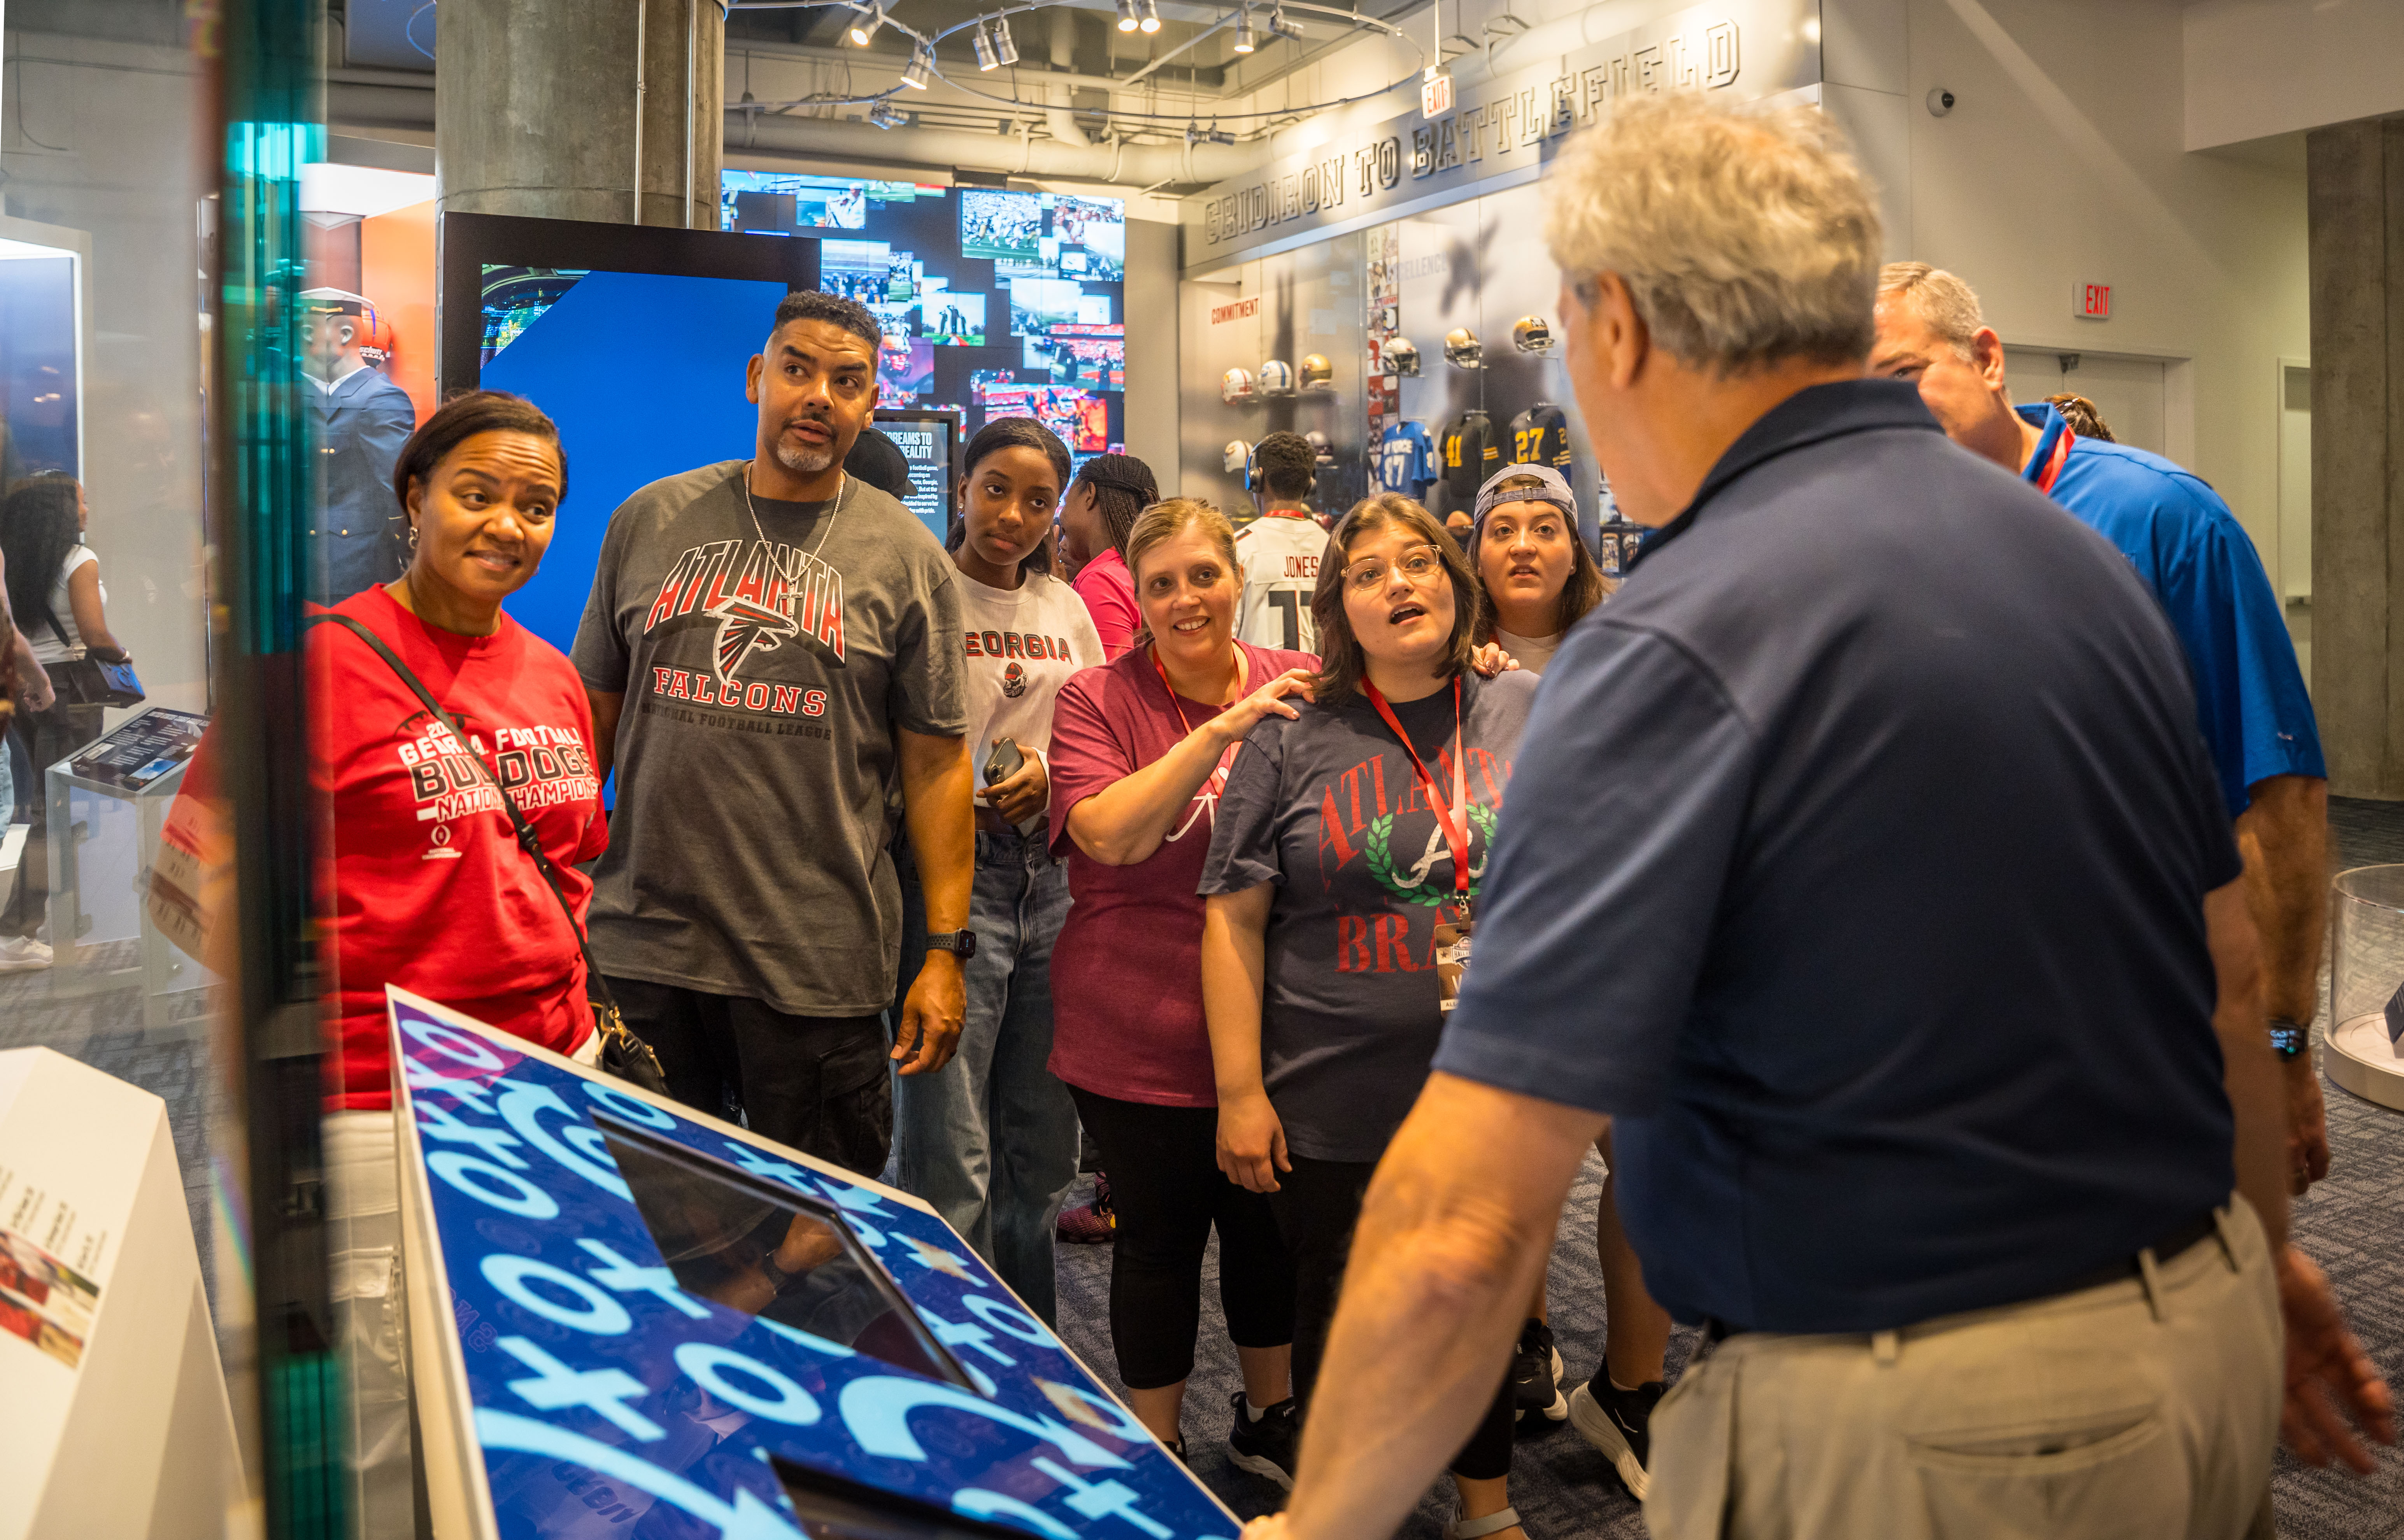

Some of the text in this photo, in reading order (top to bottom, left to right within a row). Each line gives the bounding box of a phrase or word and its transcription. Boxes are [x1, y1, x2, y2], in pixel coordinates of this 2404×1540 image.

[1427, 80, 1445, 114] EXIT
[1205, 18, 1739, 246] GRIDIRON TO BATTLEFIELD
[1211, 298, 1259, 325] COMMITMENT
[2086, 284, 2109, 315] EXIT
[921, 432, 932, 446] TO
[1446, 435, 1462, 467] 41
[1515, 427, 1545, 464] 27
[1284, 556, 1319, 578] JONES
[643, 539, 846, 664] ATLANTA
[965, 630, 1074, 666] EORGIA
[653, 667, 827, 717] FALCONS
[699, 713, 773, 734] FOOTBALL
[777, 722, 832, 741] LEAGUE
[408, 745, 594, 802] BULDOGS
[1319, 745, 1513, 894] ATLANT
